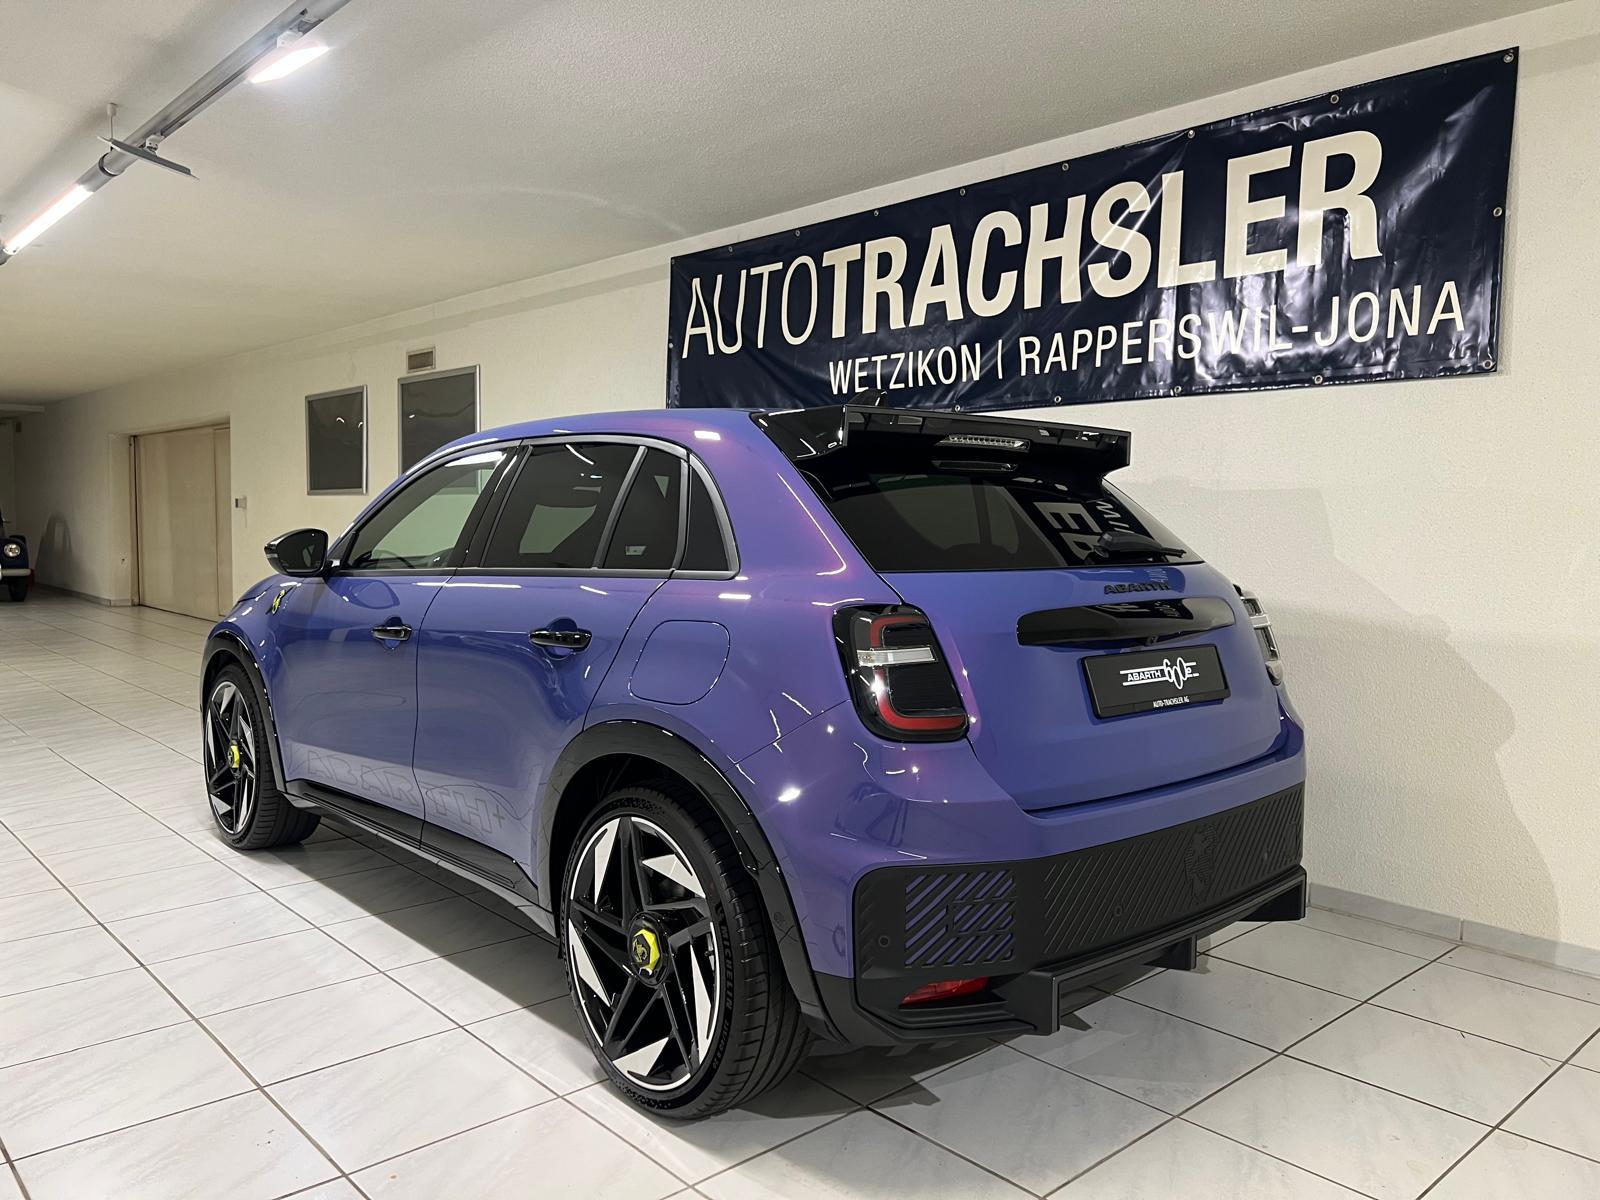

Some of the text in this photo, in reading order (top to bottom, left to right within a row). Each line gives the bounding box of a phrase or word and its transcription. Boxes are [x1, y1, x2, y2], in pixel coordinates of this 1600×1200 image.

[829, 343, 981, 395] WETZIKON
[1020, 281, 1465, 376] RAPPERSWIL-JONA
[1104, 583, 1170, 594] ABARTH
[1127, 670, 1161, 682] ABARTH
[720, 925, 734, 1010] MICHELIN
